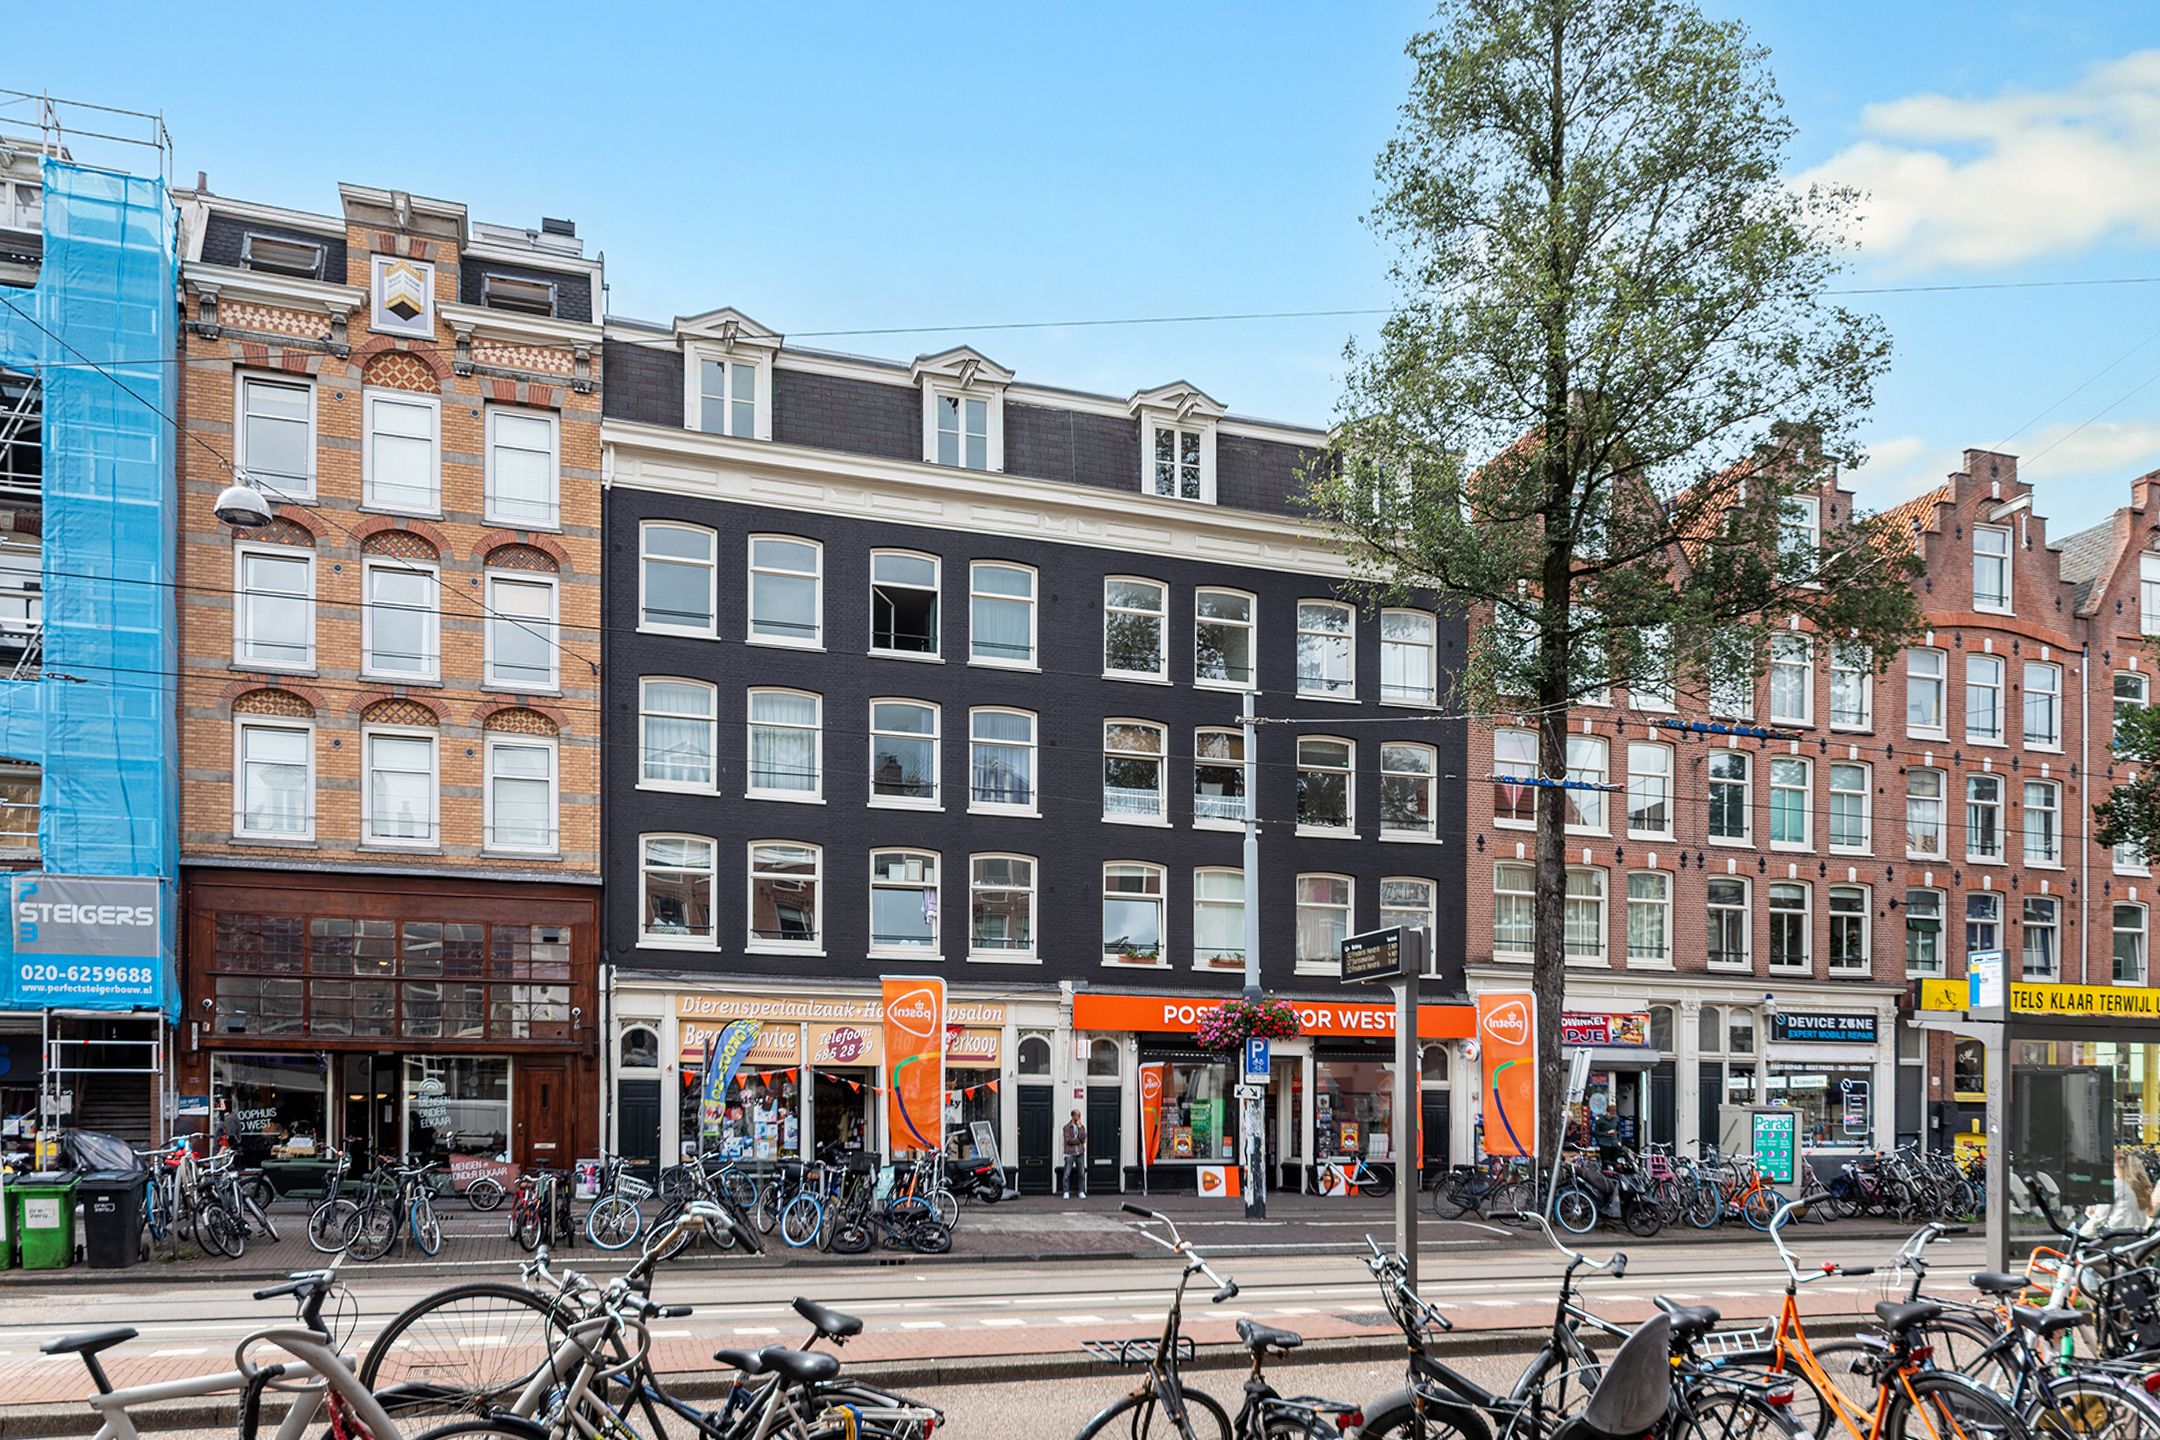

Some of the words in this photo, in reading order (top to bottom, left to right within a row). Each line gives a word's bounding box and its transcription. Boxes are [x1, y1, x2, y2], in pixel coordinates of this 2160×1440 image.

[19, 902, 154, 926] STEIGERS
[21, 964, 153, 983] 020-6259688
[21, 983, 153, 996] www.perfectsteigerbouw.nl
[681, 996, 855, 1021] Dierenspeciaalzaak
[2013, 991, 2044, 1009] TELS
[2050, 992, 2094, 1011] KLAAR
[2099, 994, 2152, 1013] TERWIJL
[1338, 1010, 1397, 1030] WEST
[1562, 1016, 1606, 1027] DWINKEL
[1788, 1016, 1836, 1029] DEVICE
[819, 1027, 873, 1046] Telefoon:
[1562, 1029, 1605, 1042] PJE
[1788, 1029, 1818, 1039] EXPERT
[1818, 1030, 1847, 1039] MOBILE
[1847, 1031, 1874, 1040] REPAIR
[814, 1046, 837, 1062] 685
[839, 1043, 855, 1058] 28
[858, 1039, 873, 1055] 29
[950, 1030, 998, 1058] erkoop
[1252, 1041, 1264, 1058] P
[238, 1107, 278, 1120] OOPHUIS
[248, 1118, 272, 1130] WEST
